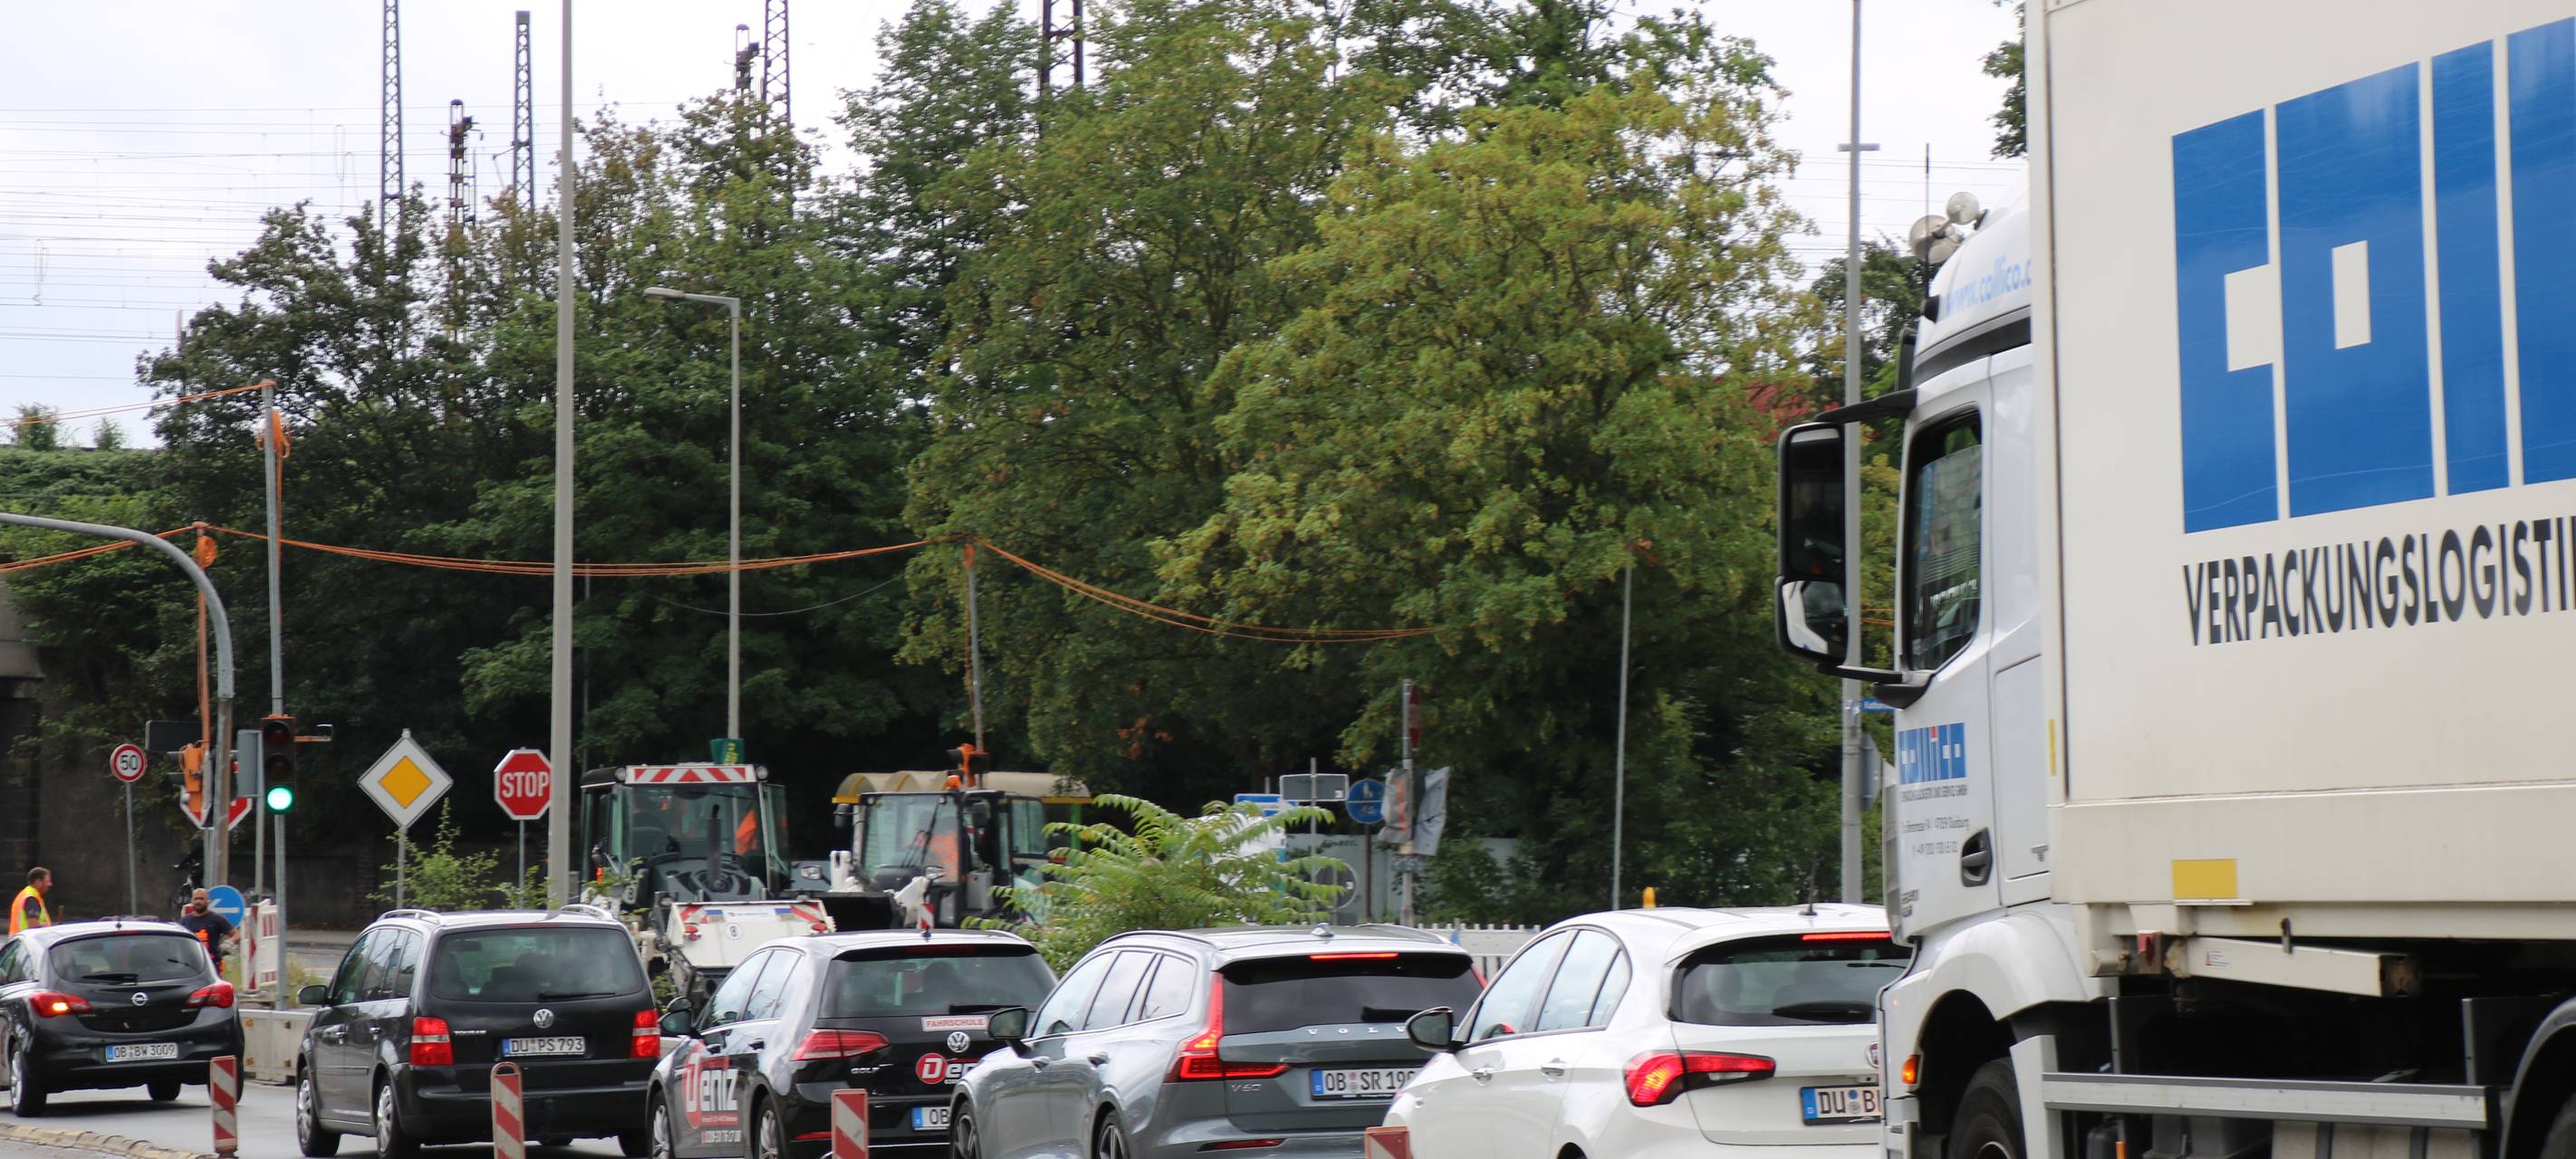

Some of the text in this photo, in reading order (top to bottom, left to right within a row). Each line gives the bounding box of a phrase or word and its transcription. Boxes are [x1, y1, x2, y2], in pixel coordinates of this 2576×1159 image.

[2182, 515, 2576, 647] VERPACKUNGSLOGISTI
[120, 754, 139, 771] 50
[502, 771, 550, 798] STOP
[927, 1018, 985, 1028] FAHRSCHULE
[114, 1044, 175, 1058] OB BW 3009
[511, 1038, 583, 1052] DU PS 793
[851, 1067, 880, 1075] GOLF
[1325, 1072, 1347, 1091] OB
[1360, 1071, 1381, 1090] SR
[1818, 1090, 1847, 1115] DU
[1862, 1089, 1881, 1113] B
[929, 1109, 950, 1125] OB
